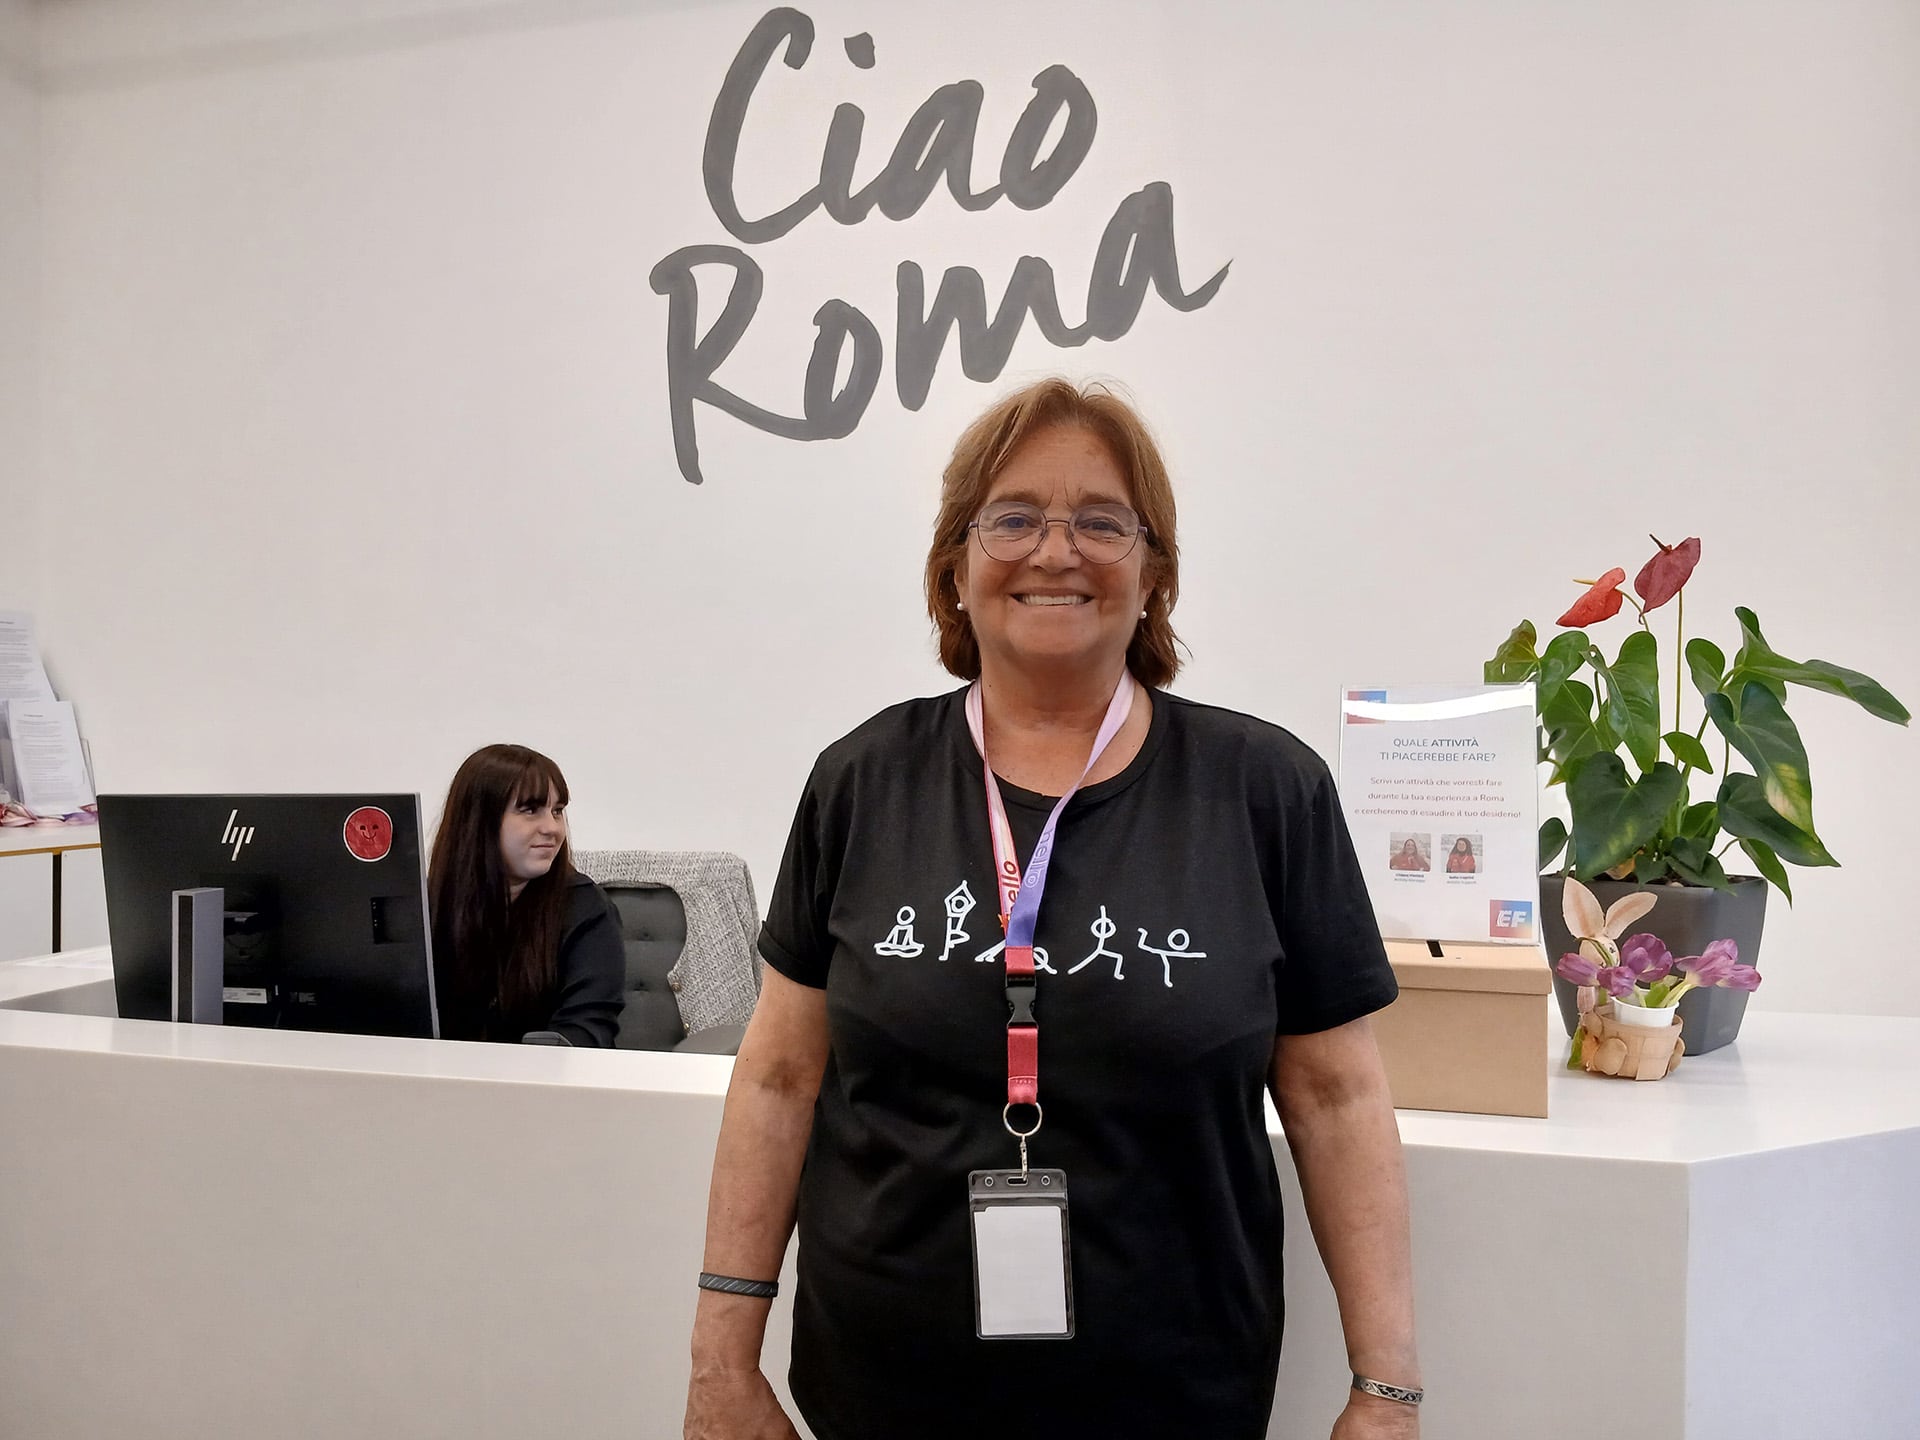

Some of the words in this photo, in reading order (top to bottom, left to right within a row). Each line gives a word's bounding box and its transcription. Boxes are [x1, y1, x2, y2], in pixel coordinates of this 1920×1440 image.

[702, 7, 1098, 245] Ciao
[649, 181, 1234, 486] Roma
[1393, 738, 1428, 747] QUALE
[1431, 736, 1479, 747] ATTIVITÀ
[1380, 752, 1389, 760] TI
[1392, 752, 1459, 761] PIACEREBBE
[1462, 752, 1496, 762] FARE?
[1370, 777, 1392, 785] Scrivi
[1393, 777, 1434, 786] un'attività
[1426, 794, 1471, 803] esperienza
[1480, 794, 1505, 802] Roma
[1000, 860, 1021, 913] ello
[1496, 910, 1527, 928] EF
